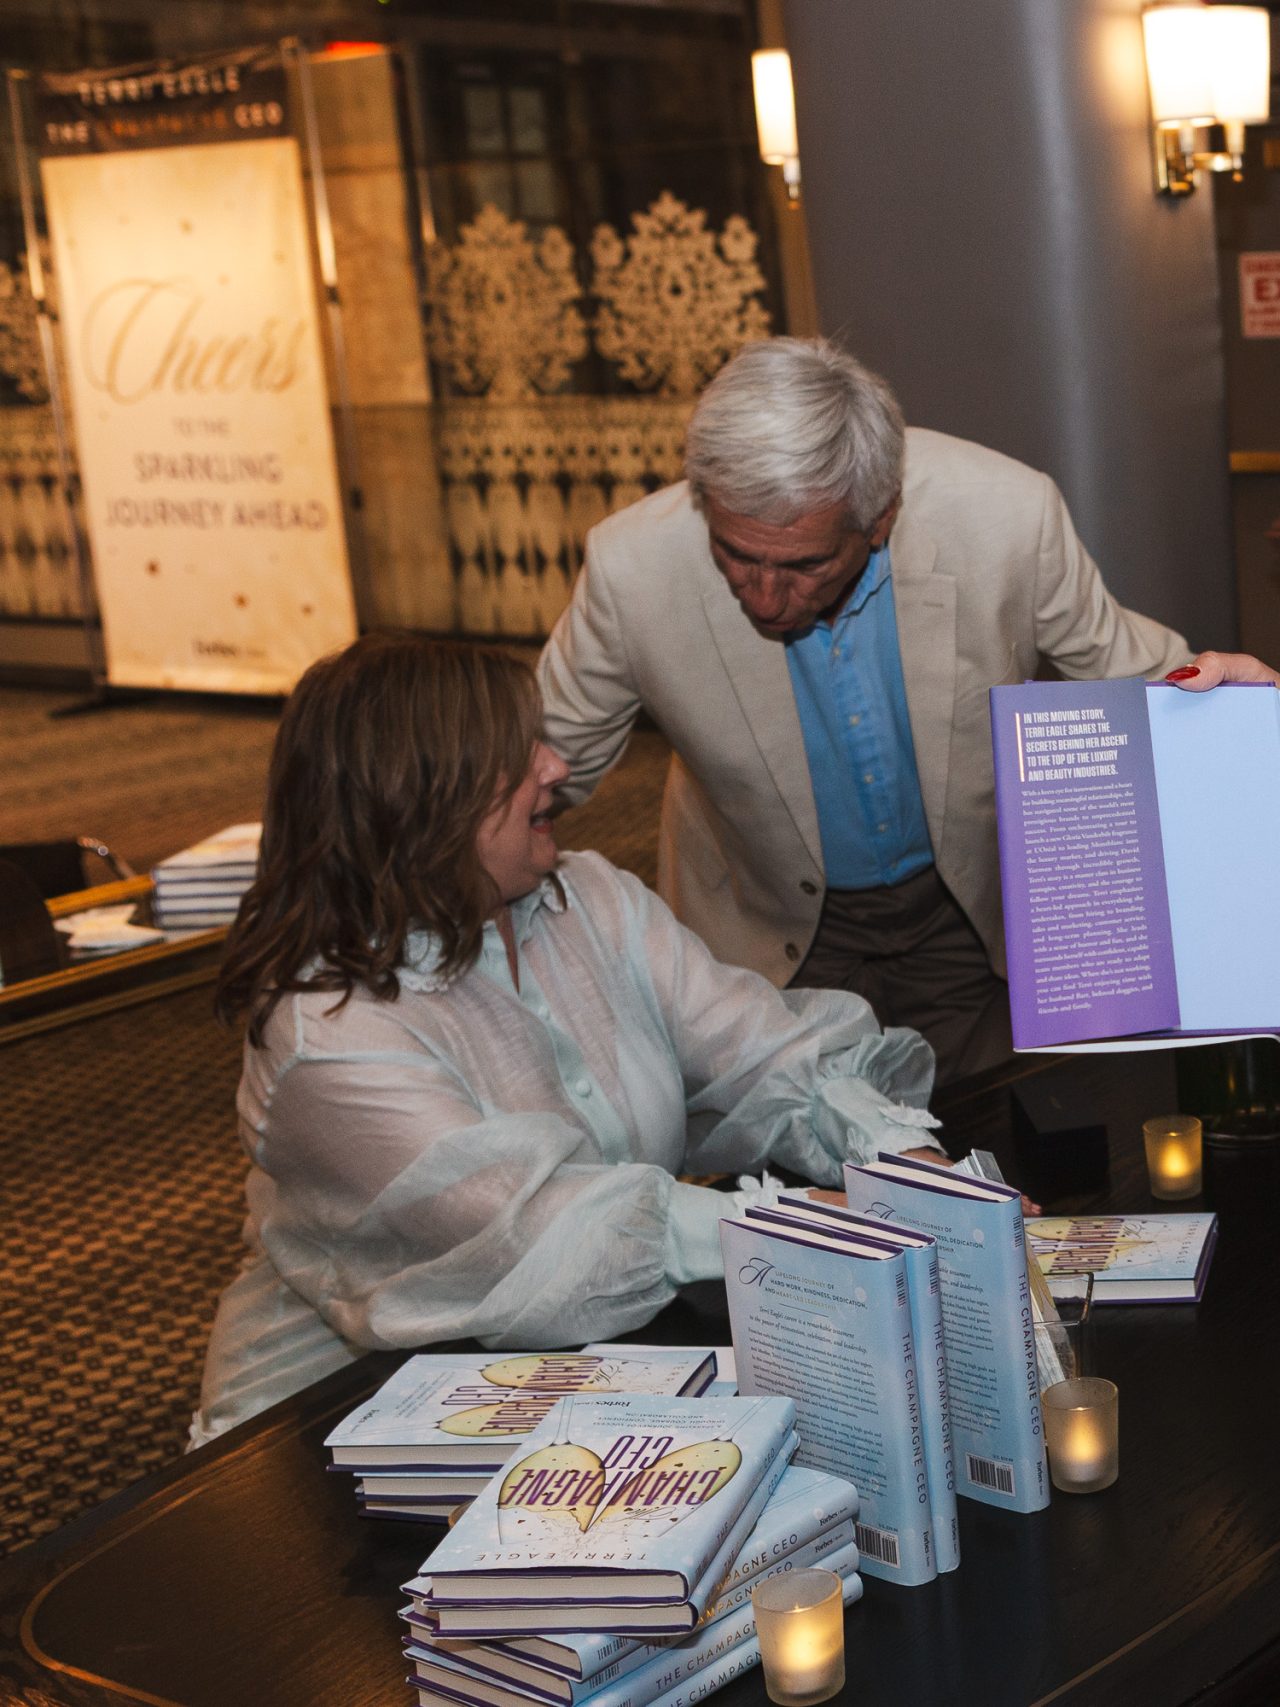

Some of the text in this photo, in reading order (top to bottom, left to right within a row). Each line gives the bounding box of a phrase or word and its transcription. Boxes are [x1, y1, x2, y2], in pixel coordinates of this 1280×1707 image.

[82, 277, 308, 405] Cheers
[134, 452, 284, 486] SPARKLING
[104, 498, 329, 532] JOURNEY AHEAD
[1024, 709, 1106, 723] IN THIS MOVING STORY,
[1025, 722, 1111, 738] TERRI EAGLE SHARES THE
[1026, 735, 1128, 752] SECRETS BEHIND HER ASCENT
[1027, 750, 1118, 767] TO THE TOP OF THE LUXURY
[1029, 764, 1119, 782] AND BEAUTY INDUSTRIES.
[764, 1287, 776, 1295] AND
[770, 1279, 869, 1310] HARD WORK, KINDNESS, DEDICATION,
[1018, 1273, 1040, 1435] THE CHAMPAGNE CEO
[441, 1385, 518, 1406] CEO
[934, 1323, 954, 1490] THE CHAMPAGNE CEO
[902, 1332, 927, 1504] THE CHAMPAGNE CEO
[600, 1435, 674, 1470] CEO
[496, 1468, 721, 1507] CHAMPAGNE
[819, 1511, 838, 1526] Forbes
[772, 1534, 798, 1555] CEO
[815, 1537, 834, 1553] Forbes
[473, 1552, 649, 1563] TERRI EAGLE
[655, 1619, 756, 1690] THE CHAMPAG
